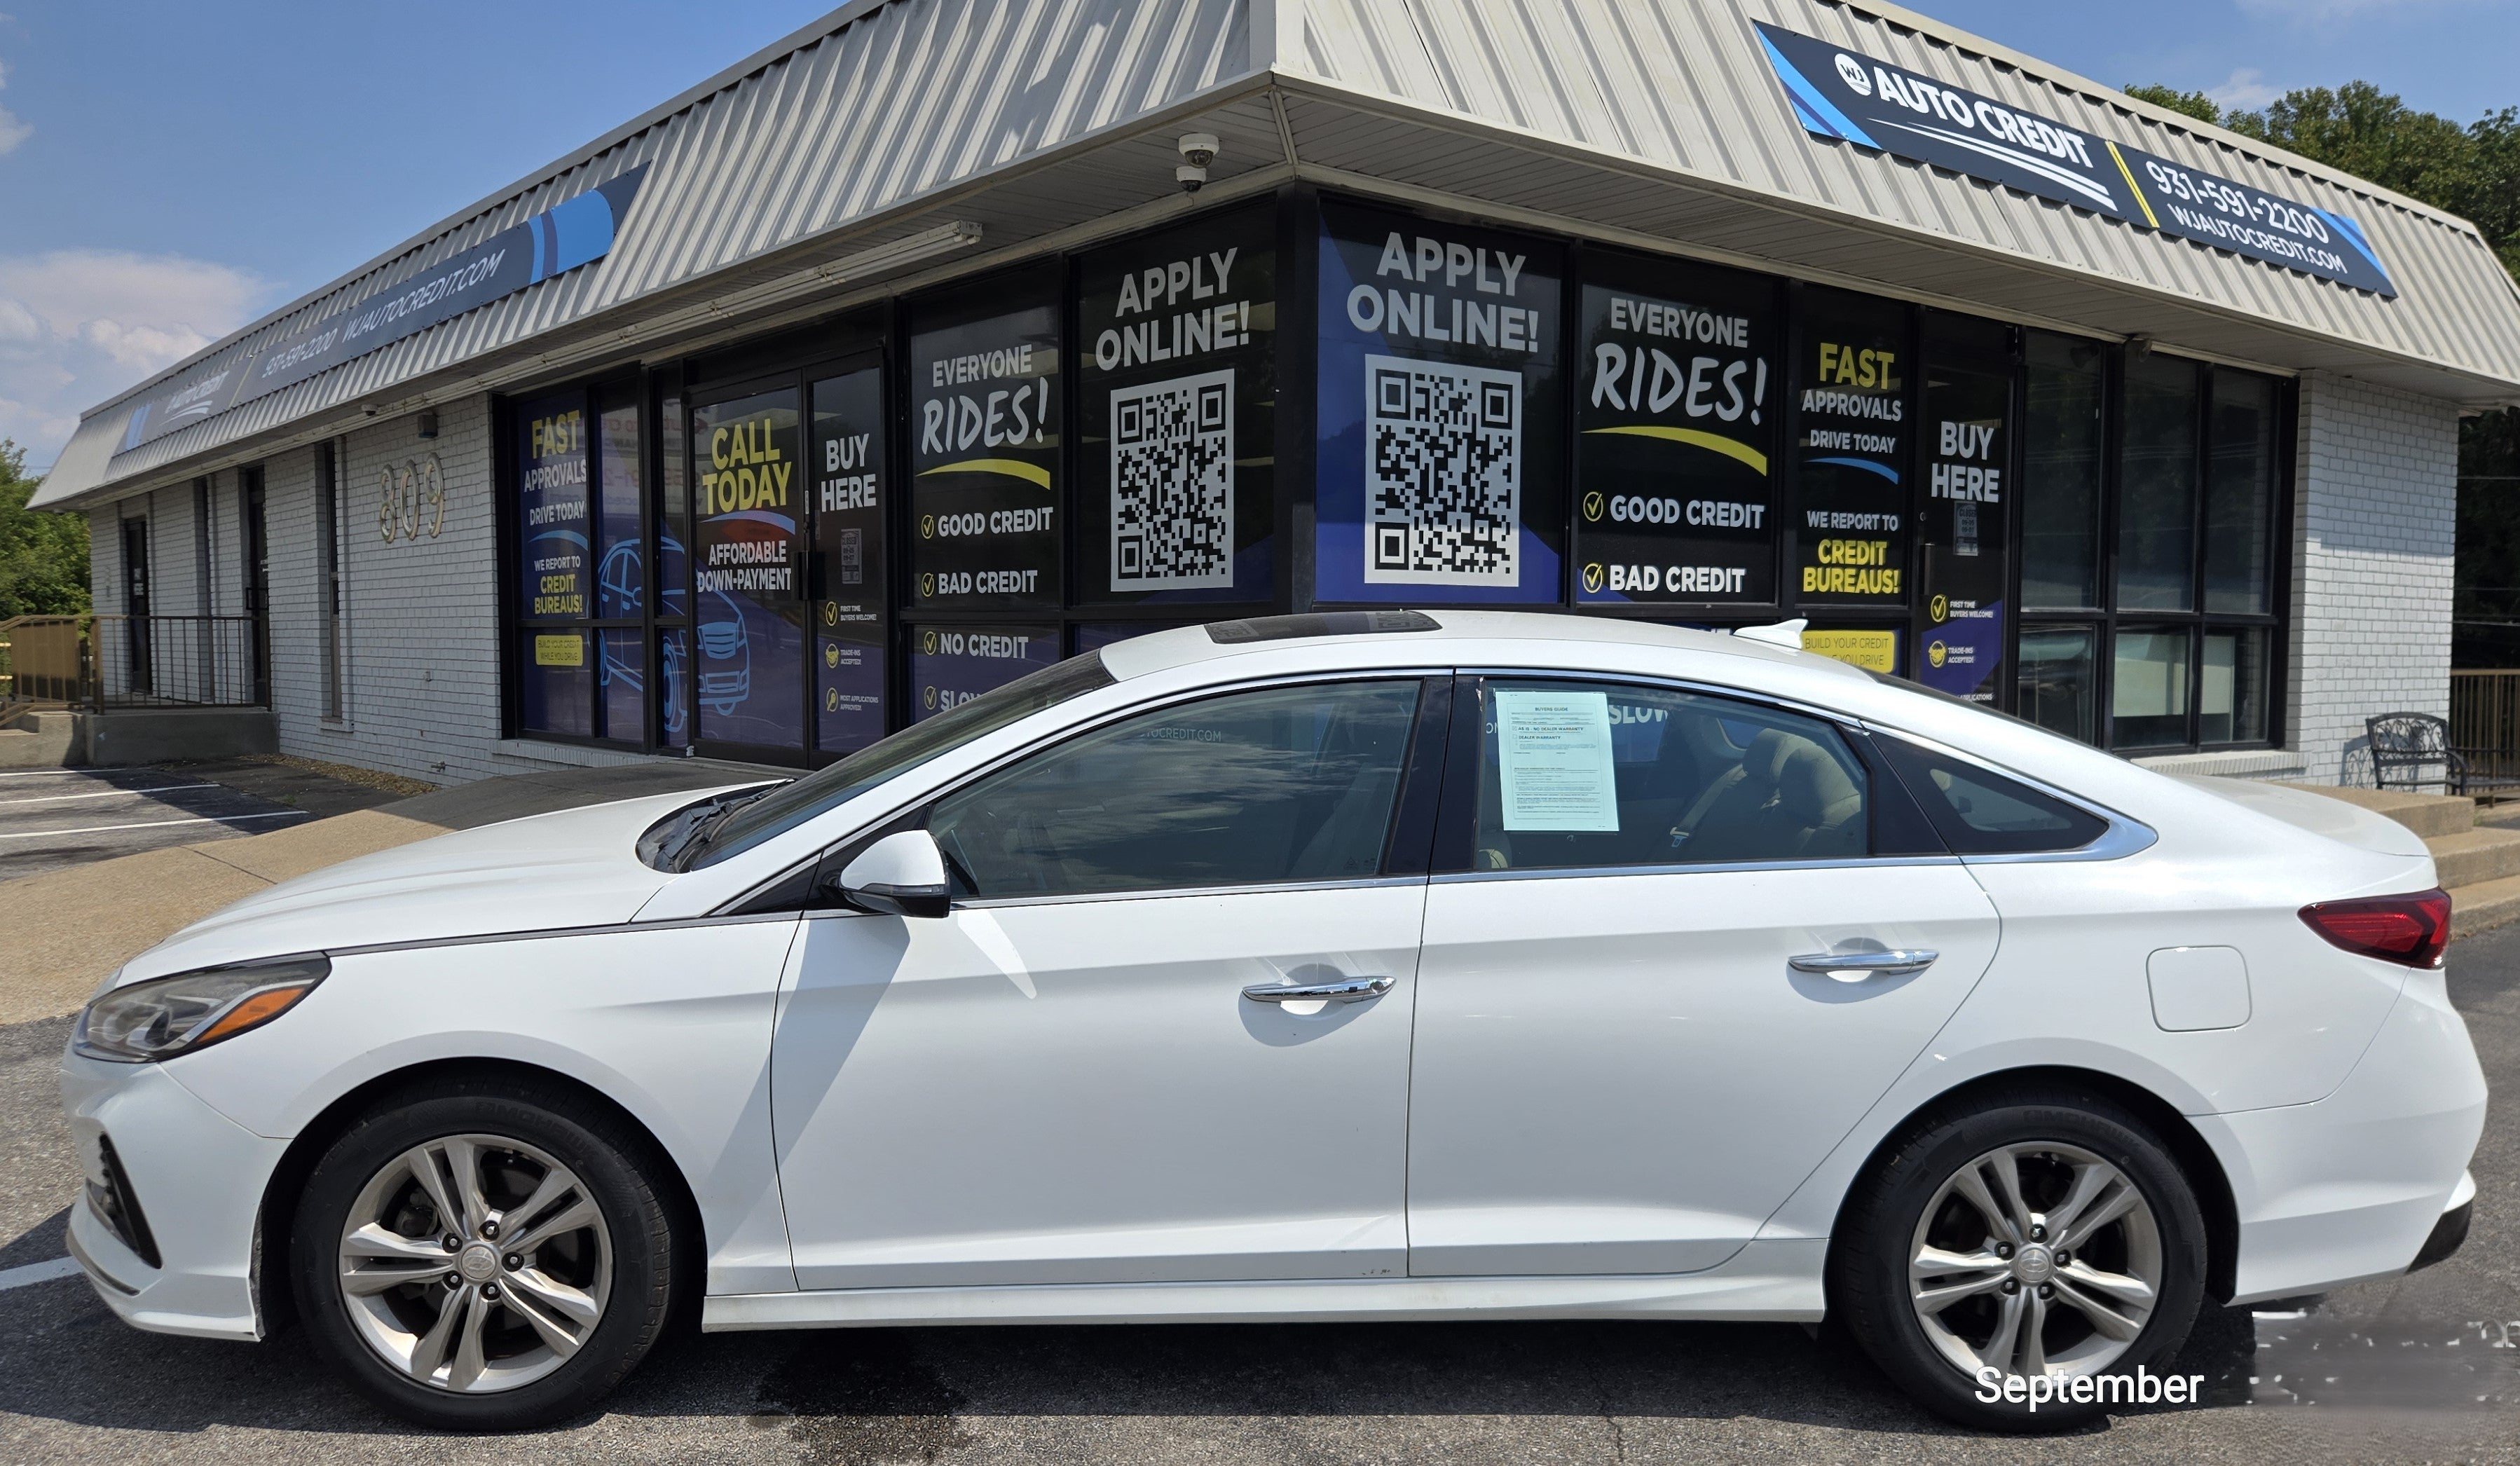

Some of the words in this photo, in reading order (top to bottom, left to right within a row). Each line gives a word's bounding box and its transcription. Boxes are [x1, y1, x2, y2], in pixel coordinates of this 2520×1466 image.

[1840, 63, 1865, 83] WJ
[1873, 66, 1975, 128] AUTO
[1973, 100, 2094, 168] CREDIT
[2145, 160, 2329, 244] 931-591-2200
[2167, 203, 2348, 274] WJAUTOCREDIT.COM
[1115, 247, 1239, 318] APPLY
[1376, 231, 1526, 297] APPLY
[261, 327, 338, 379] 931-591-2200
[341, 248, 506, 343] WJAUTOCREDIT.COM
[1346, 283, 1539, 353] ONLINE!
[1610, 297, 1749, 349] EVERYONE
[1095, 300, 1250, 372] ONLINE!
[932, 343, 1032, 388] EVERYONE
[1591, 342, 1767, 426] RIDES!
[1819, 343, 1895, 390] FAST
[920, 376, 1049, 455] RIDES!
[1802, 390, 1902, 422] APPROVALS
[532, 409, 580, 459] FAST
[711, 418, 780, 470] CALL
[826, 433, 870, 472] BUY
[1810, 429, 1851, 451] DRIVE
[1854, 433, 1896, 454] TODAY
[1940, 421, 1994, 461] BUY
[524, 458, 587, 492] APPROVALS
[702, 461, 792, 514] TODAY
[821, 473, 877, 512] HERE
[1931, 463, 2000, 503] HERE
[380, 452, 444, 544] 809
[530, 504, 554, 526] DRIVE
[556, 500, 585, 523] TODAY
[1610, 494, 1680, 526] GOOD
[1685, 500, 1765, 529] CREDIT
[938, 514, 985, 537] GOOD
[989, 506, 1054, 534] CREDIT
[1807, 510, 1827, 528] WE
[1830, 512, 1879, 531] REPORT
[1882, 514, 1898, 532] TO
[534, 560, 545, 571] WE
[545, 557, 570, 569] REPORT
[571, 556, 581, 568] TO
[708, 540, 786, 566] AFFORDABLE
[1817, 539, 1887, 566] CREDIT
[540, 573, 576, 594] CREDIT
[697, 568, 792, 593] DOWN-PAYMENT
[938, 573, 973, 596] BAD
[976, 570, 1038, 594] CREDIT
[1610, 564, 1660, 592] BAD
[1665, 565, 1747, 594] CREDIT
[1802, 567, 1899, 595] BUREAUS!
[534, 594, 583, 615] BUREAUS!
[940, 633, 964, 655] NO
[968, 633, 1029, 659] CREDIT
[1805, 638, 1830, 649] BUILD
[1833, 637, 1857, 649] YOUR
[1859, 638, 1889, 649] CREDIT
[1860, 655, 1884, 666] DRIVE
